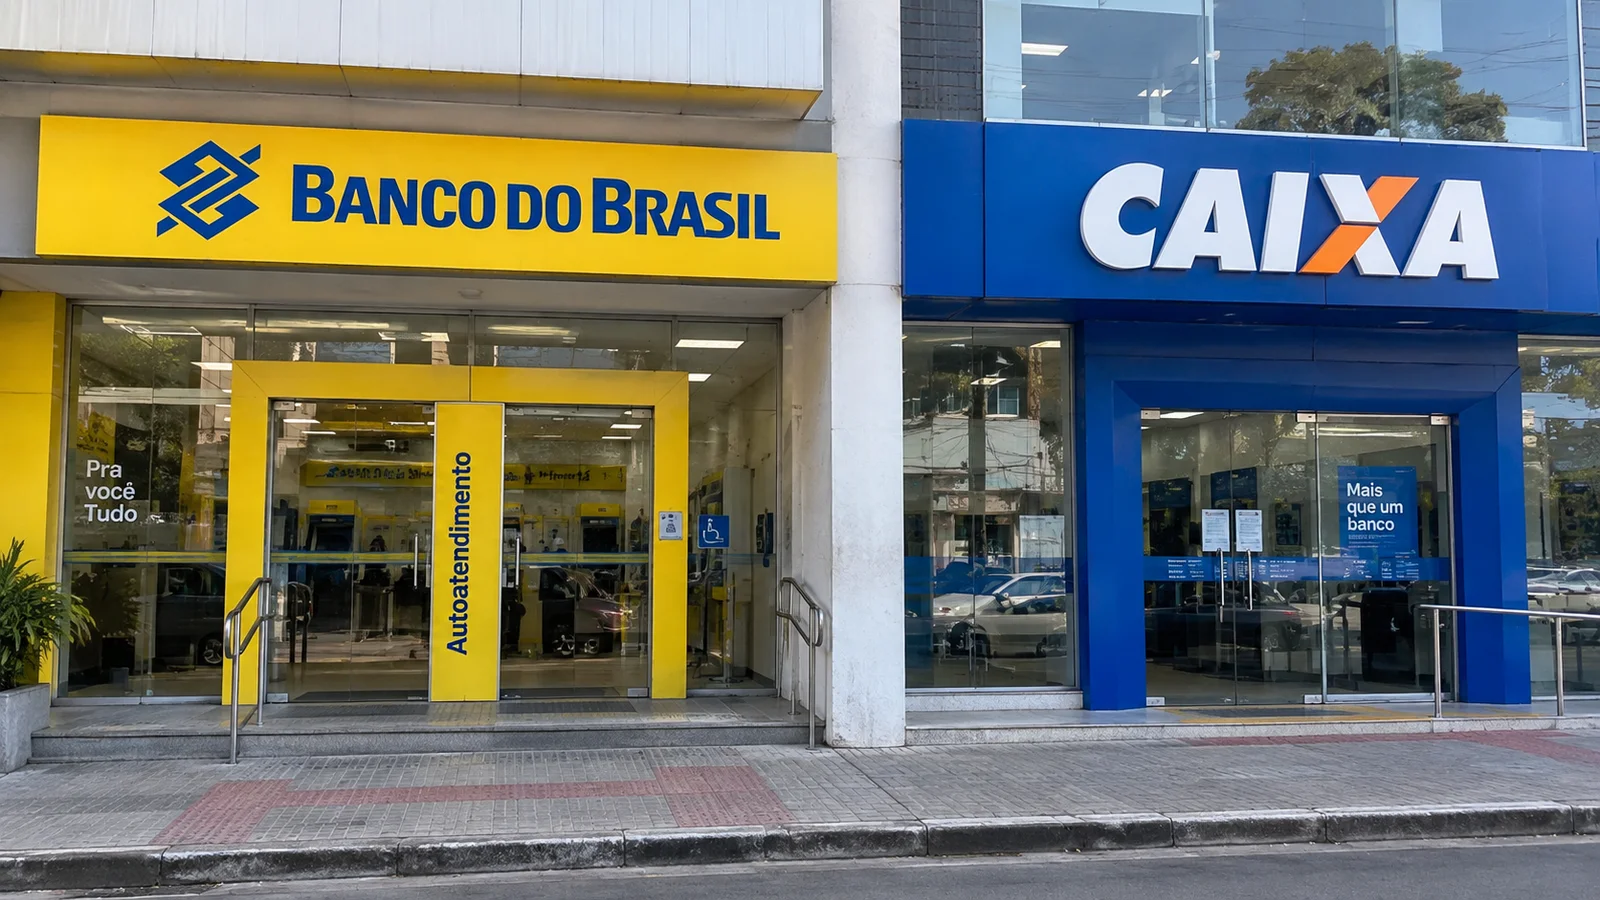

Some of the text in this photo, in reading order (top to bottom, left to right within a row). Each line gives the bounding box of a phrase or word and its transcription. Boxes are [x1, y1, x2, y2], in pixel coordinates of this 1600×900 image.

[292, 164, 496, 229] BANCO
[592, 177, 780, 241] BRASIL
[1080, 162, 1499, 279] CAIXA
[86, 459, 122, 479] Pra
[85, 482, 136, 500] você
[1347, 482, 1383, 497] Mais
[84, 504, 138, 523] Tudo
[1347, 502, 1404, 517] que um
[1347, 516, 1395, 531] banco
[447, 452, 471, 655] Autoatendimento
